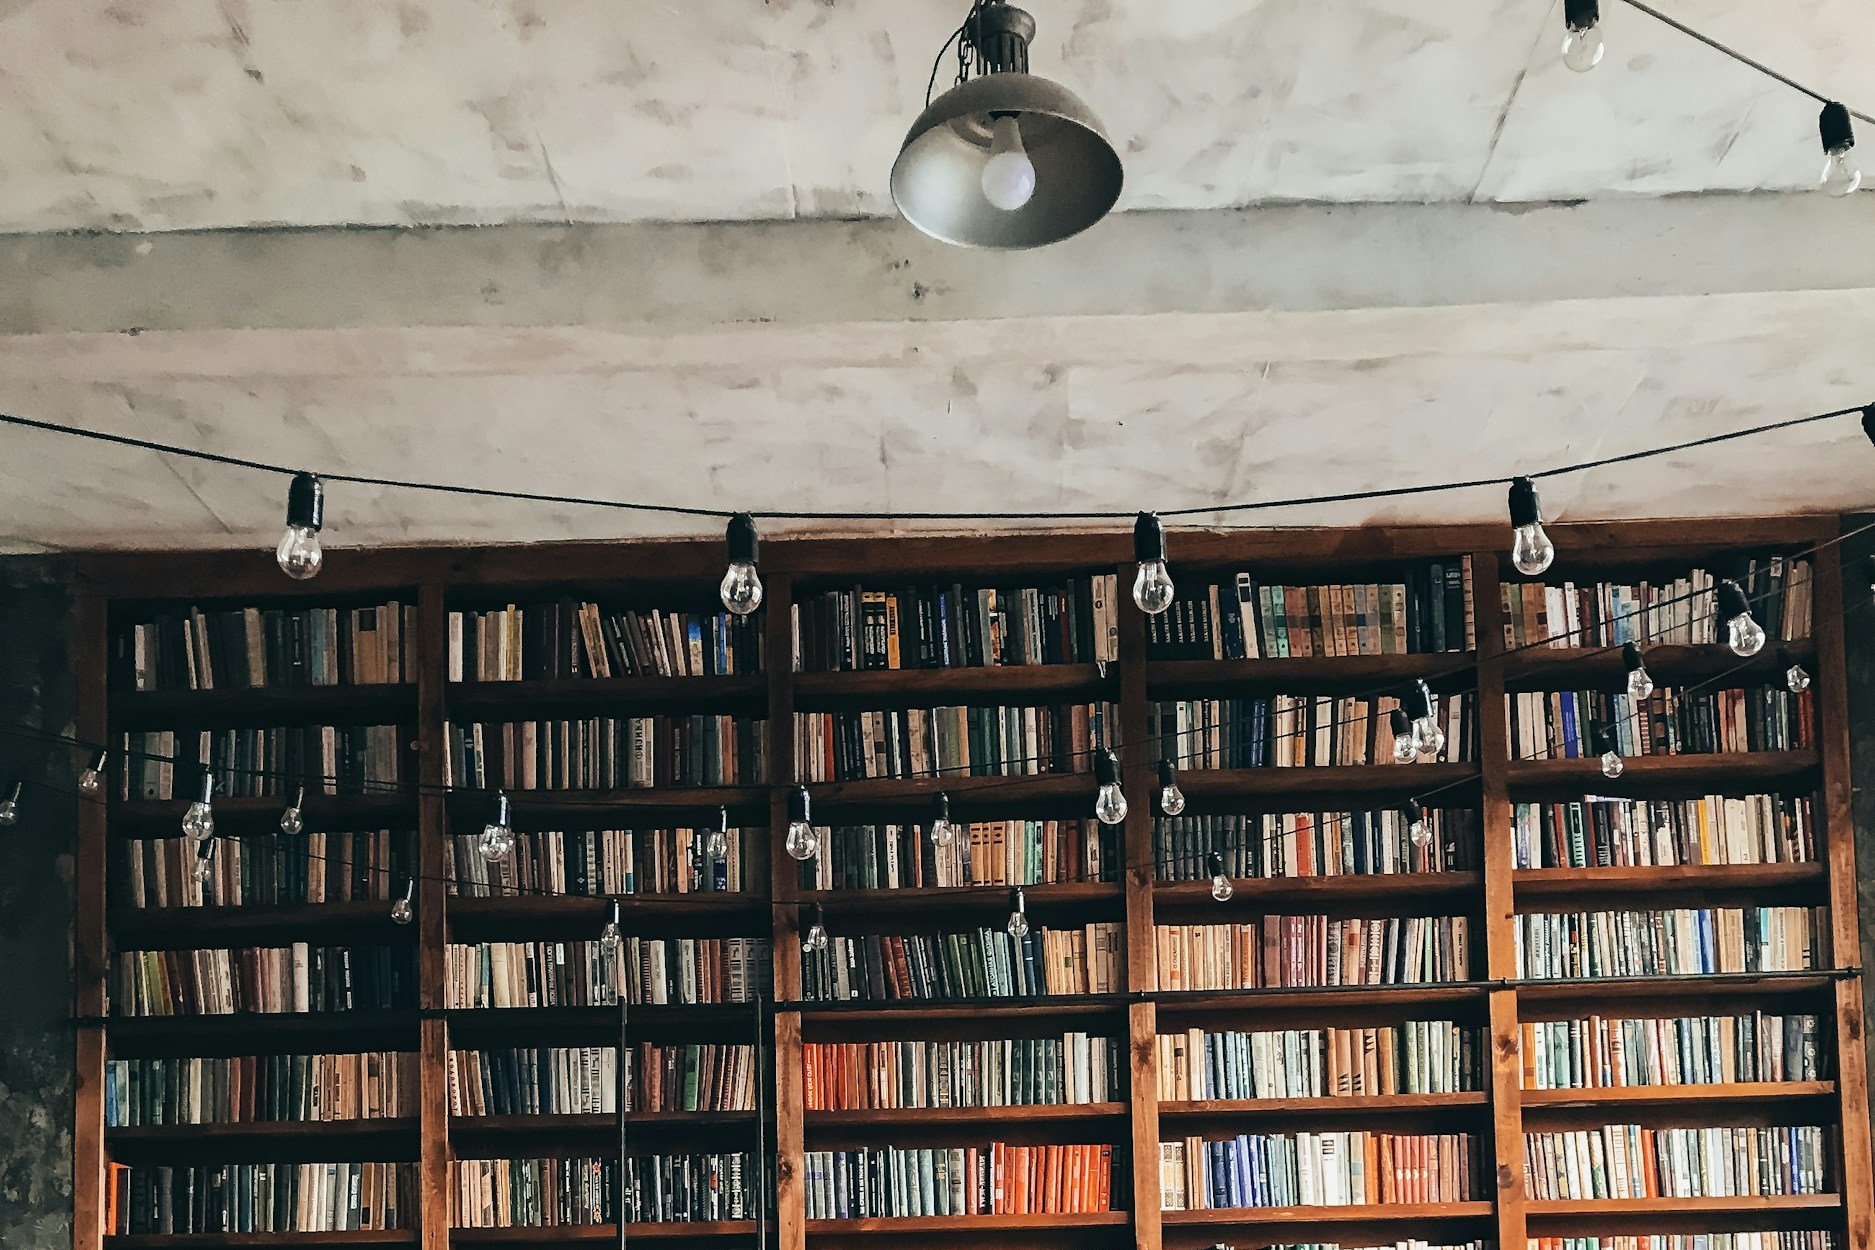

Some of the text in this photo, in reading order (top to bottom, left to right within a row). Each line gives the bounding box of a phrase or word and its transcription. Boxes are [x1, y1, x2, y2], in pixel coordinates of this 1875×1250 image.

[634, 718, 643, 760] ФИЗИКА
[984, 930, 996, 987] АТОМНАЯ ФИЗИКА
